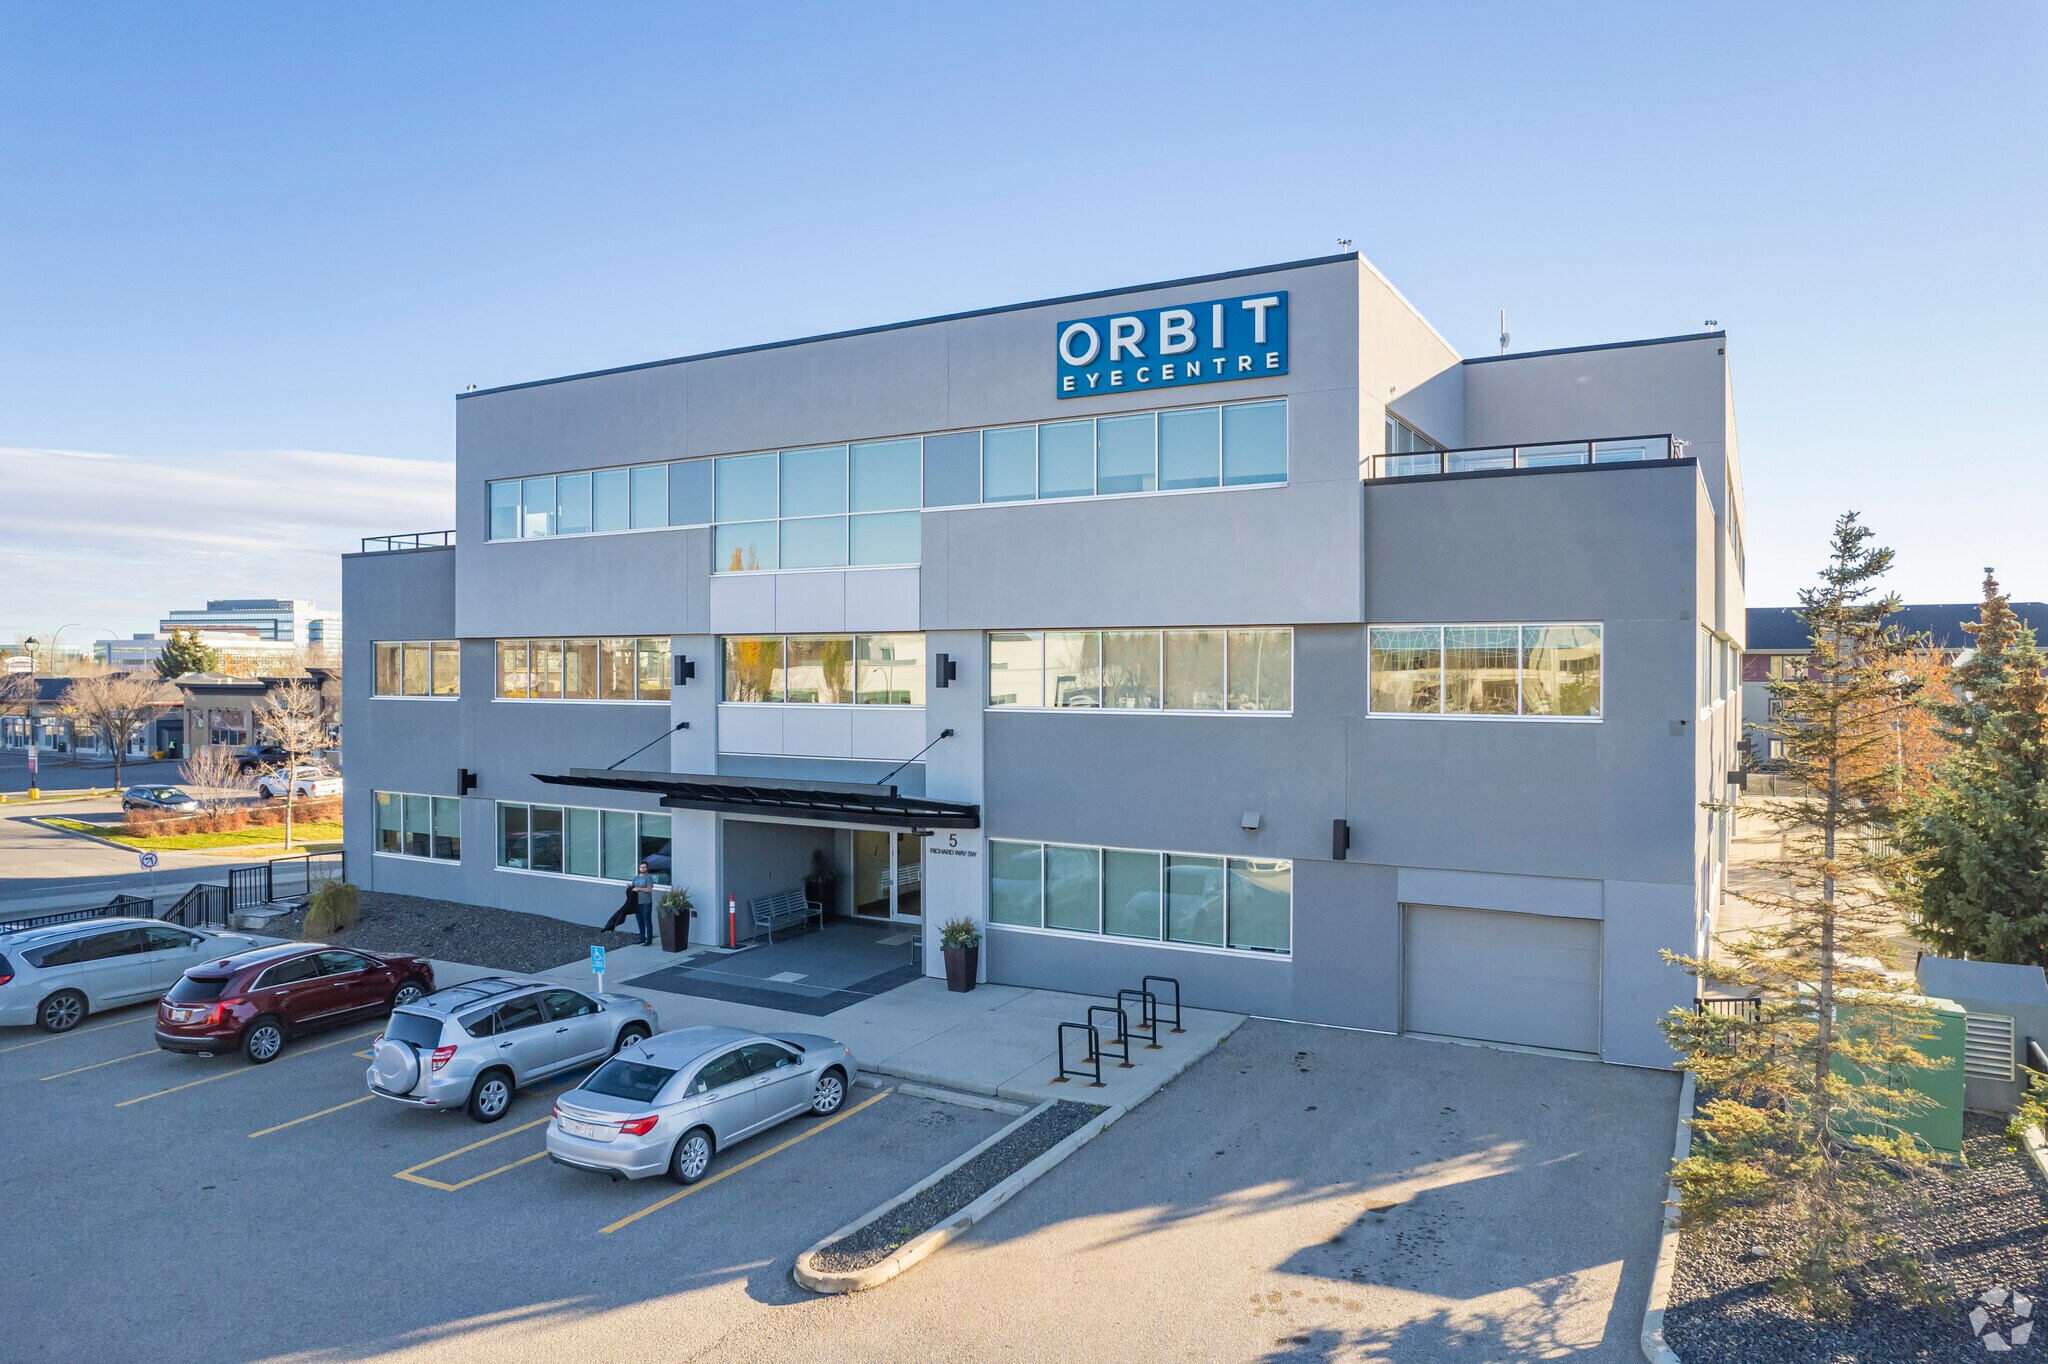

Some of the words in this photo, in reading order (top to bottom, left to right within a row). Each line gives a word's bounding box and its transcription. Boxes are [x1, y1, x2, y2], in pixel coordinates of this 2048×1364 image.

[1059, 296, 1280, 367] ORBIT
[1063, 351, 1280, 392] EYECENTRE
[949, 833, 957, 847] 5
